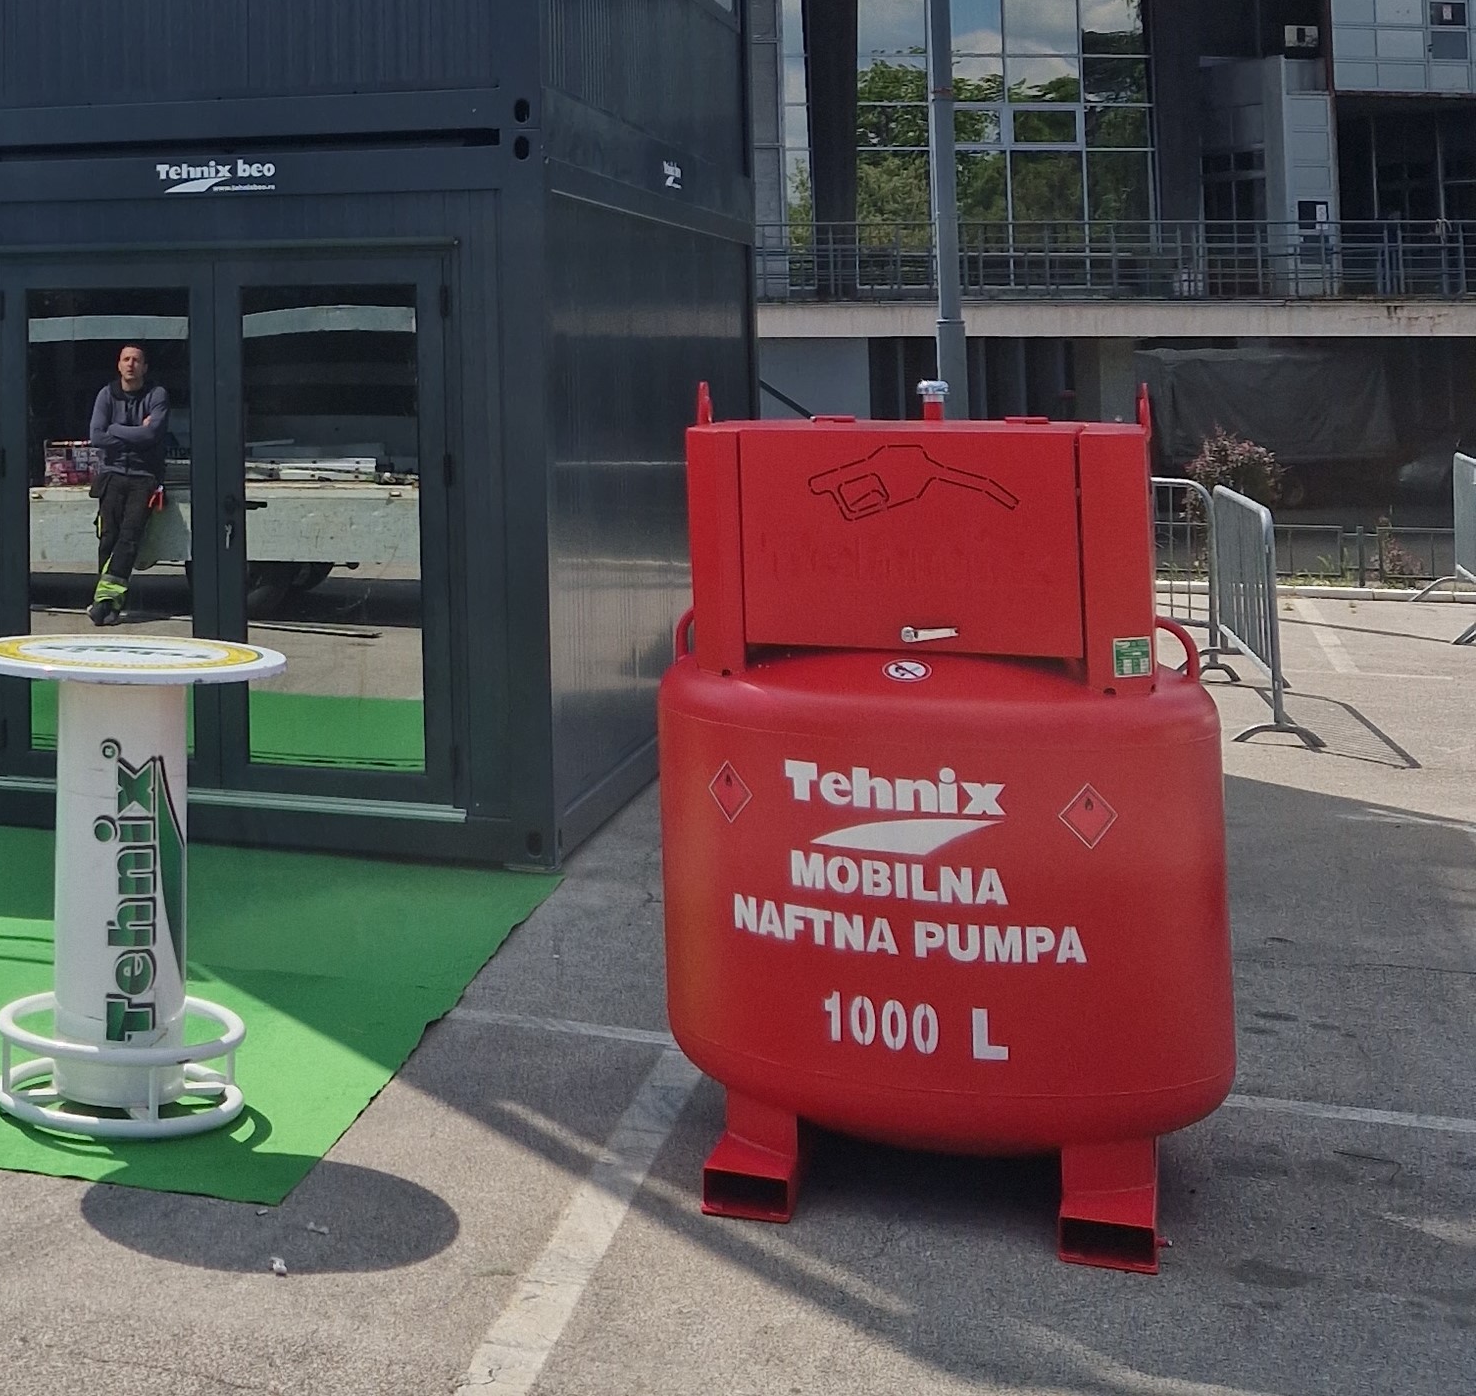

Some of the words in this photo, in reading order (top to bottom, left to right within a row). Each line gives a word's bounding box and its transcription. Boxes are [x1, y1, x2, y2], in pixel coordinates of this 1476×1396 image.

[155, 160, 233, 180] Tehnix
[237, 159, 276, 177] beo
[784, 758, 1007, 816] Tehnix
[791, 849, 1009, 906] MOBILNA
[732, 893, 900, 956] NAFTNA
[913, 920, 1088, 964] PUMPA
[824, 990, 940, 1054] 1000
[971, 1007, 1010, 1062] L
